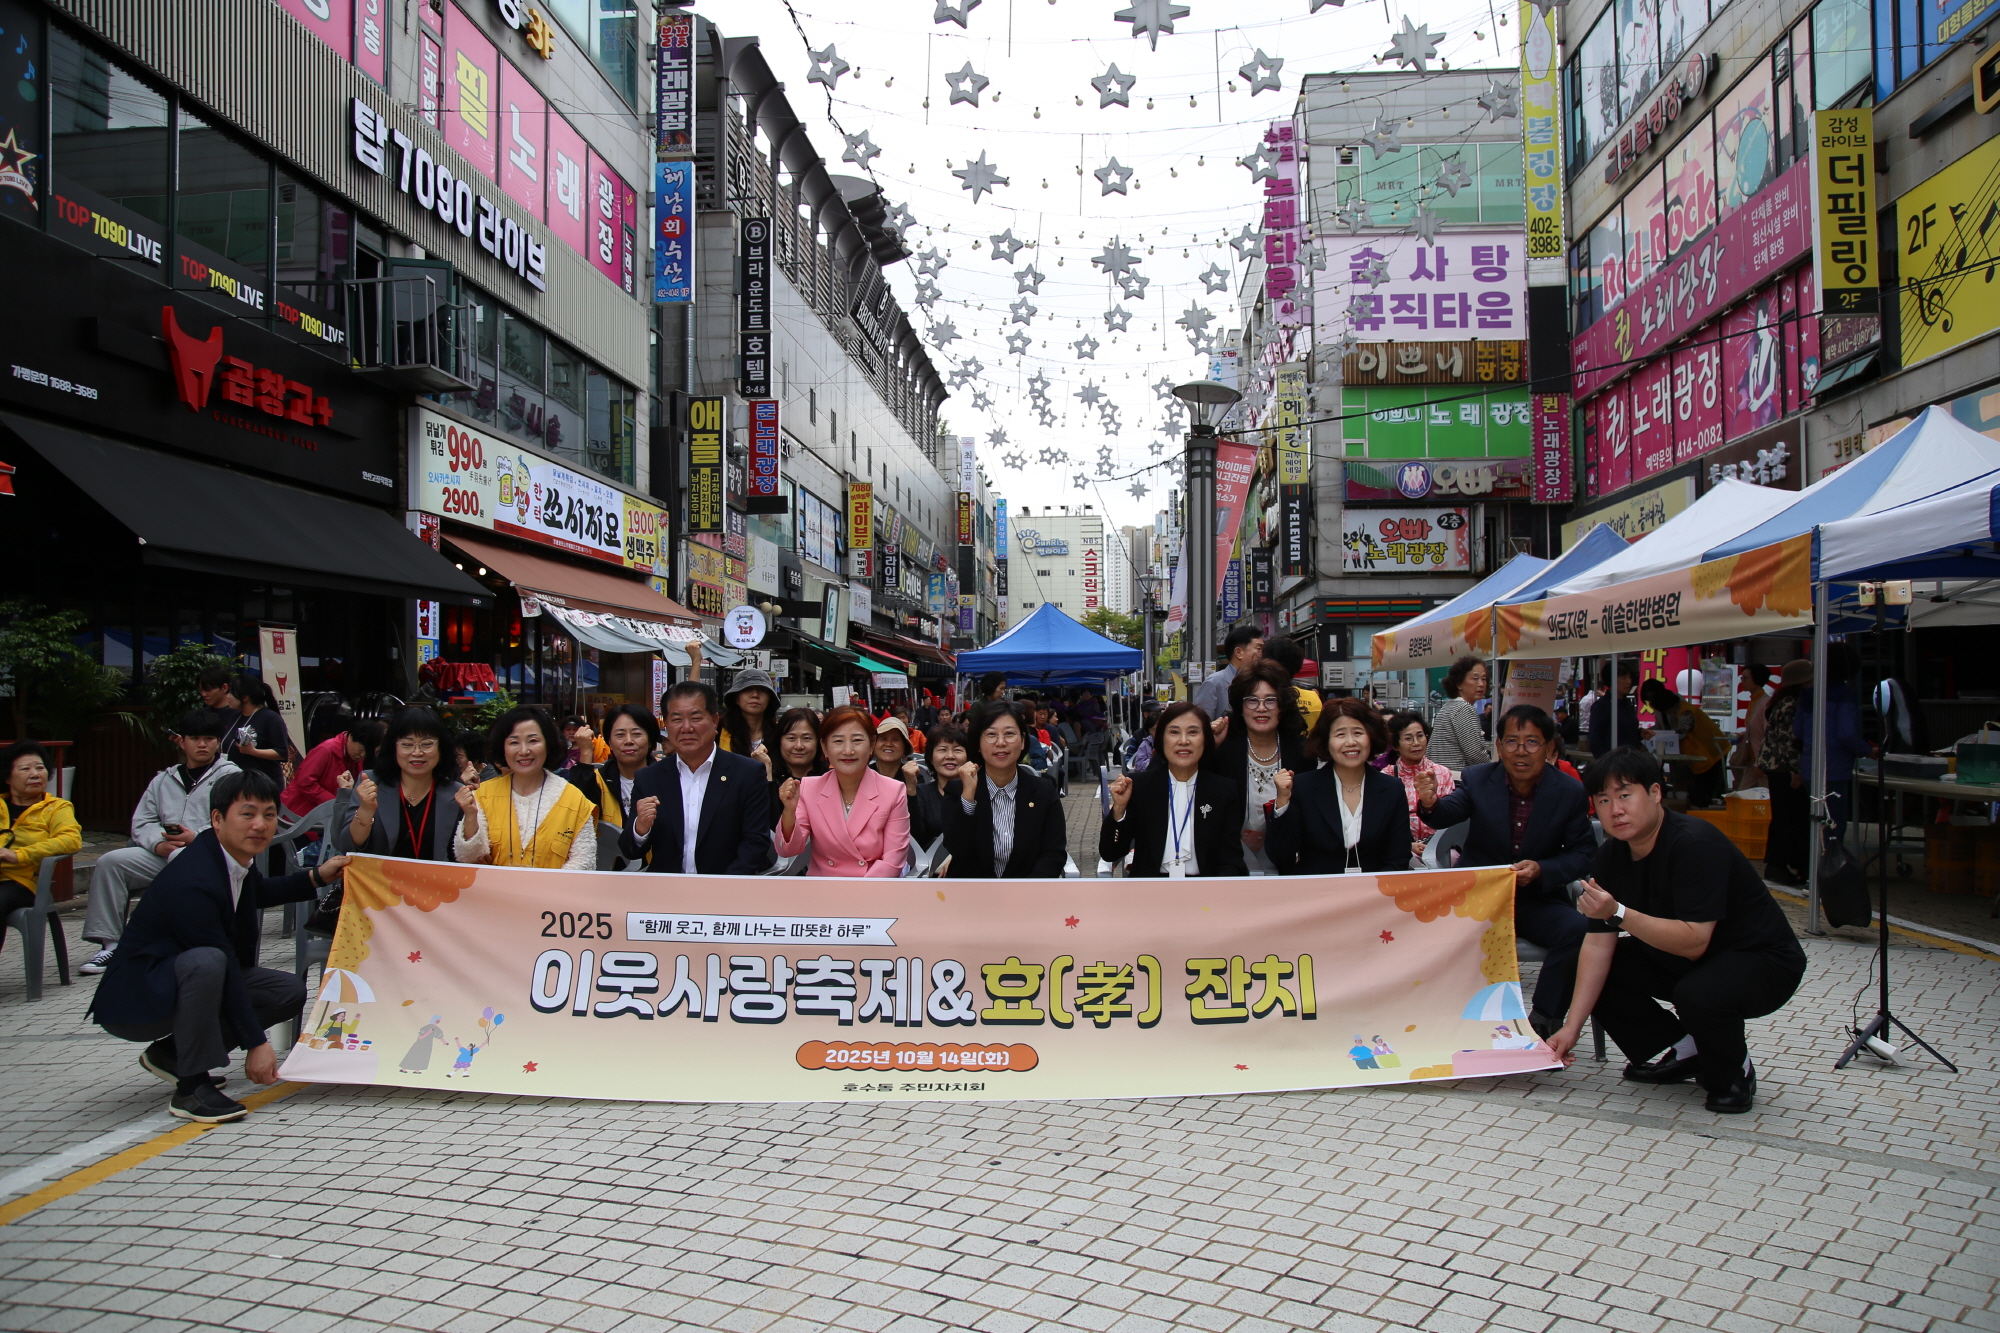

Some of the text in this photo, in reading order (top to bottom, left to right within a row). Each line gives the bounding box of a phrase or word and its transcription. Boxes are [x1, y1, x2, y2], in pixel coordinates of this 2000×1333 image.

[661, 51, 689, 131] 노래광장
[1828, 117, 1858, 134] 감성
[1821, 135, 1867, 149] 라이브
[390, 127, 473, 238] 7090
[475, 194, 547, 293] 라이브
[1774, 184, 1790, 208] 완비
[55, 194, 163, 265] TOP 7090 LIVE
[1783, 202, 1799, 228] 완비
[1827, 153, 1868, 285] 더필링
[1906, 202, 1936, 256] 2F
[1530, 236, 1560, 254] 3983
[1752, 248, 1770, 272] 단체
[180, 254, 265, 312] TOP 7090 LIVE
[748, 246, 764, 329] 브라운도트
[1640, 234, 1726, 347] 노래광장
[277, 301, 346, 345] TOP 7090 LIVE
[746, 337, 766, 381] 호텔
[1358, 343, 1464, 381] 이쁘니
[11, 364, 98, 400] 가맹문의 1688-3689
[1633, 346, 1721, 437] 노래광장
[1371, 406, 1422, 424] 이쁘니
[292, 431, 319, 452] PLUS
[690, 400, 721, 464] 애플
[430, 440, 444, 457] 튀김
[1541, 416, 1562, 485] 노래광장
[1645, 445, 1673, 472] 예약문의
[1676, 423, 1723, 458] 414-0082
[1285, 459, 1302, 467] 헤어
[1285, 466, 1302, 474] 네일
[850, 484, 871, 493] 7080
[1432, 464, 1498, 496] 오빠
[1545, 487, 1562, 499] 2F
[690, 473, 700, 523] 남자도우미
[627, 509, 655, 536] 1900
[854, 502, 870, 538] 라이브
[1379, 518, 1433, 543] 오빠
[1440, 514, 1461, 529] 2층
[625, 535, 655, 565] 생맥주
[855, 539, 868, 547] 2F
[1365, 542, 1449, 565] 노래광장
[885, 556, 898, 587] 라이브
[961, 596, 972, 604] 2F
[1547, 609, 1589, 641] 의료지원
[1601, 591, 1682, 635] 해솔한방병원
[1408, 635, 1433, 658] 운영본부석
[540, 910, 613, 940] 2025
[676, 920, 708, 937] 웃고,
[712, 921, 741, 936] 함께
[744, 922, 786, 938] 나누는
[790, 922, 833, 938] 따뜻한
[1184, 953, 1318, 1026] 잔치
[825, 1049, 1010, 1066] 2025년 10월 14일(화)
[842, 1082, 986, 1092] 호수동 주민자치회
